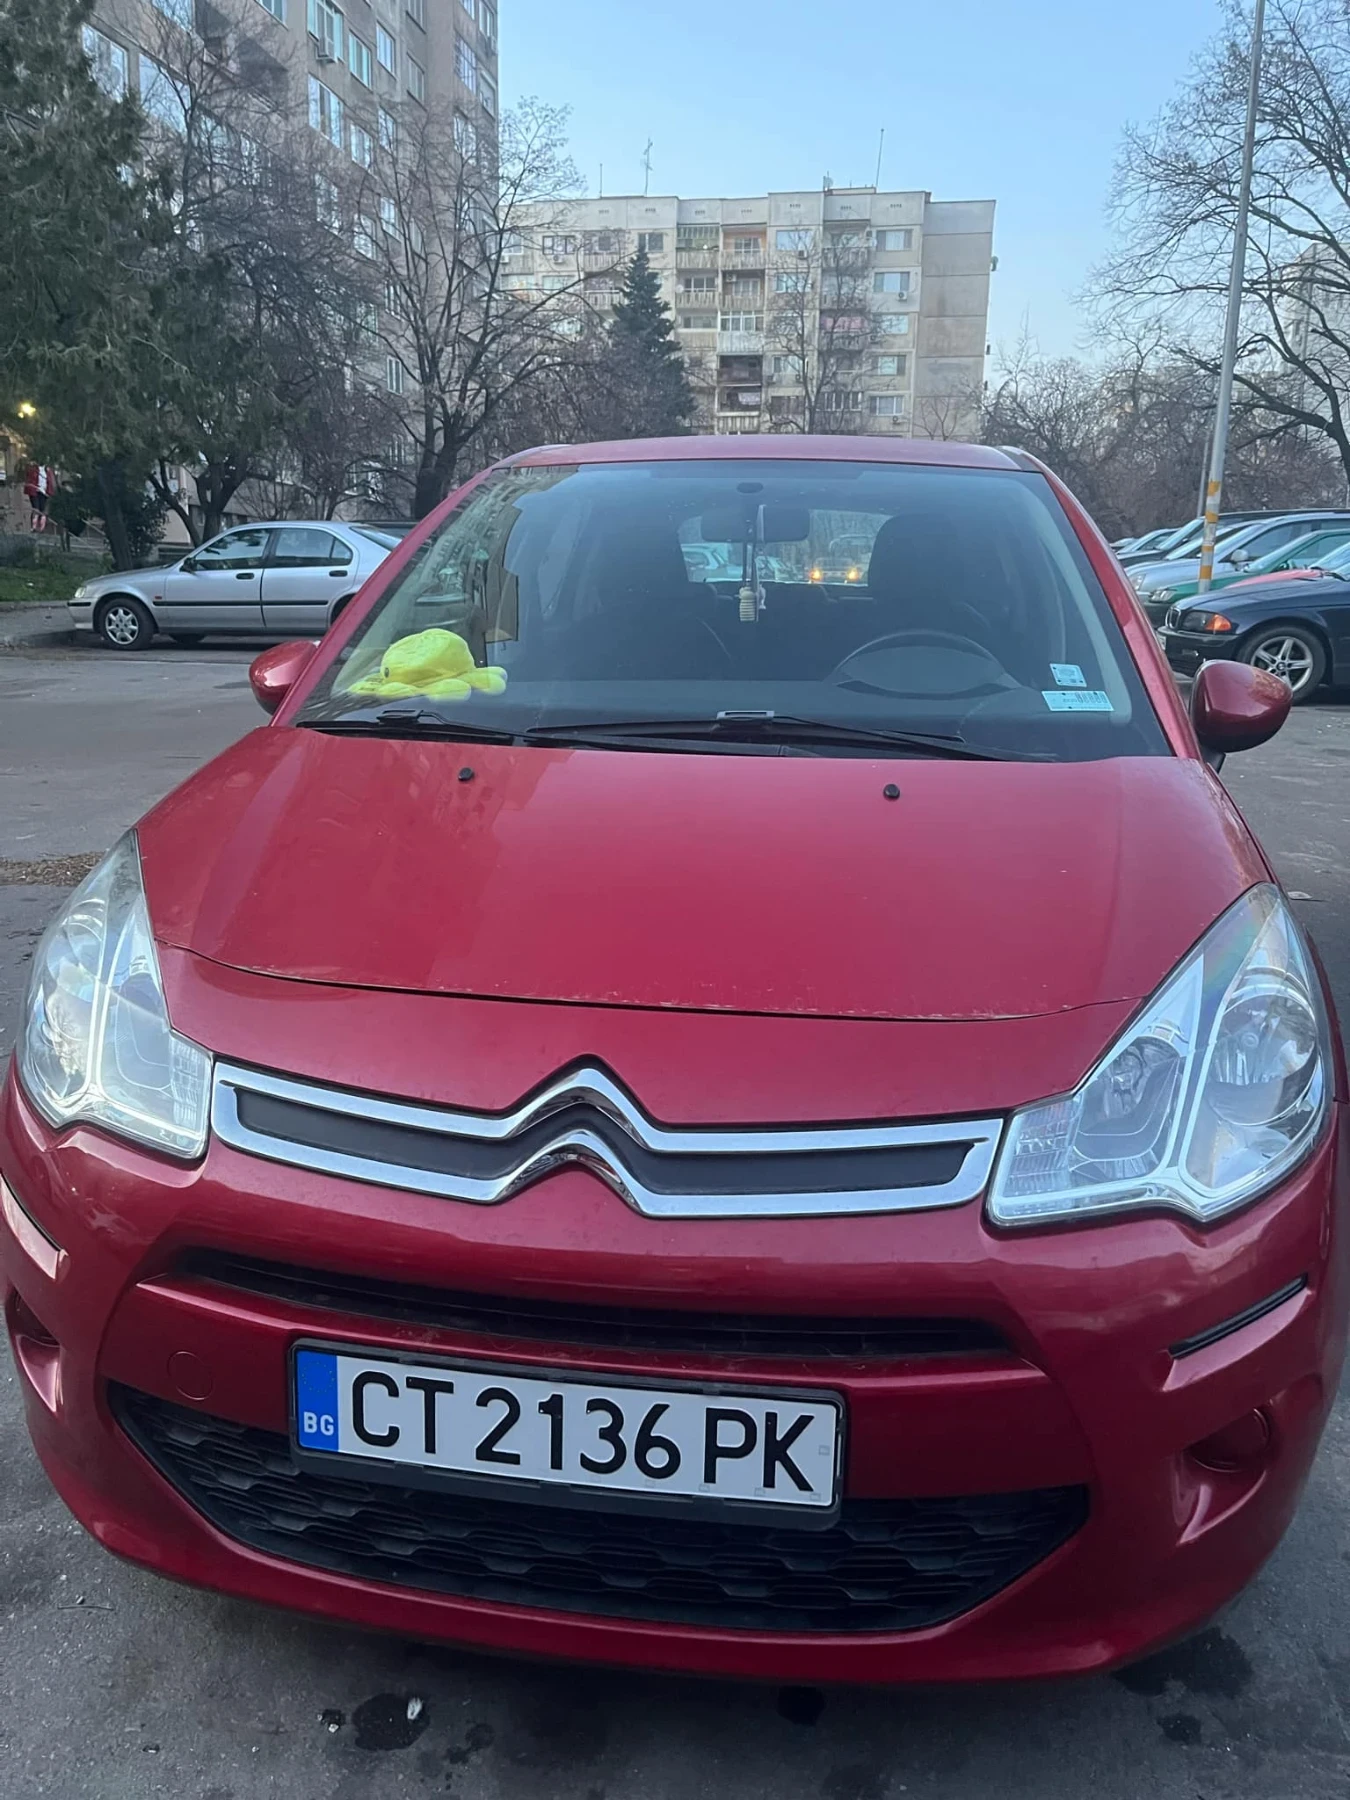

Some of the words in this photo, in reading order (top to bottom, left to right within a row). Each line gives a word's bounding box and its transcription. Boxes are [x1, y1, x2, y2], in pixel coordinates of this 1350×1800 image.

[303, 1411, 335, 1436] BG
[352, 1370, 454, 1455] CT
[475, 1387, 681, 1480] 2136
[704, 1407, 815, 1491] PK
